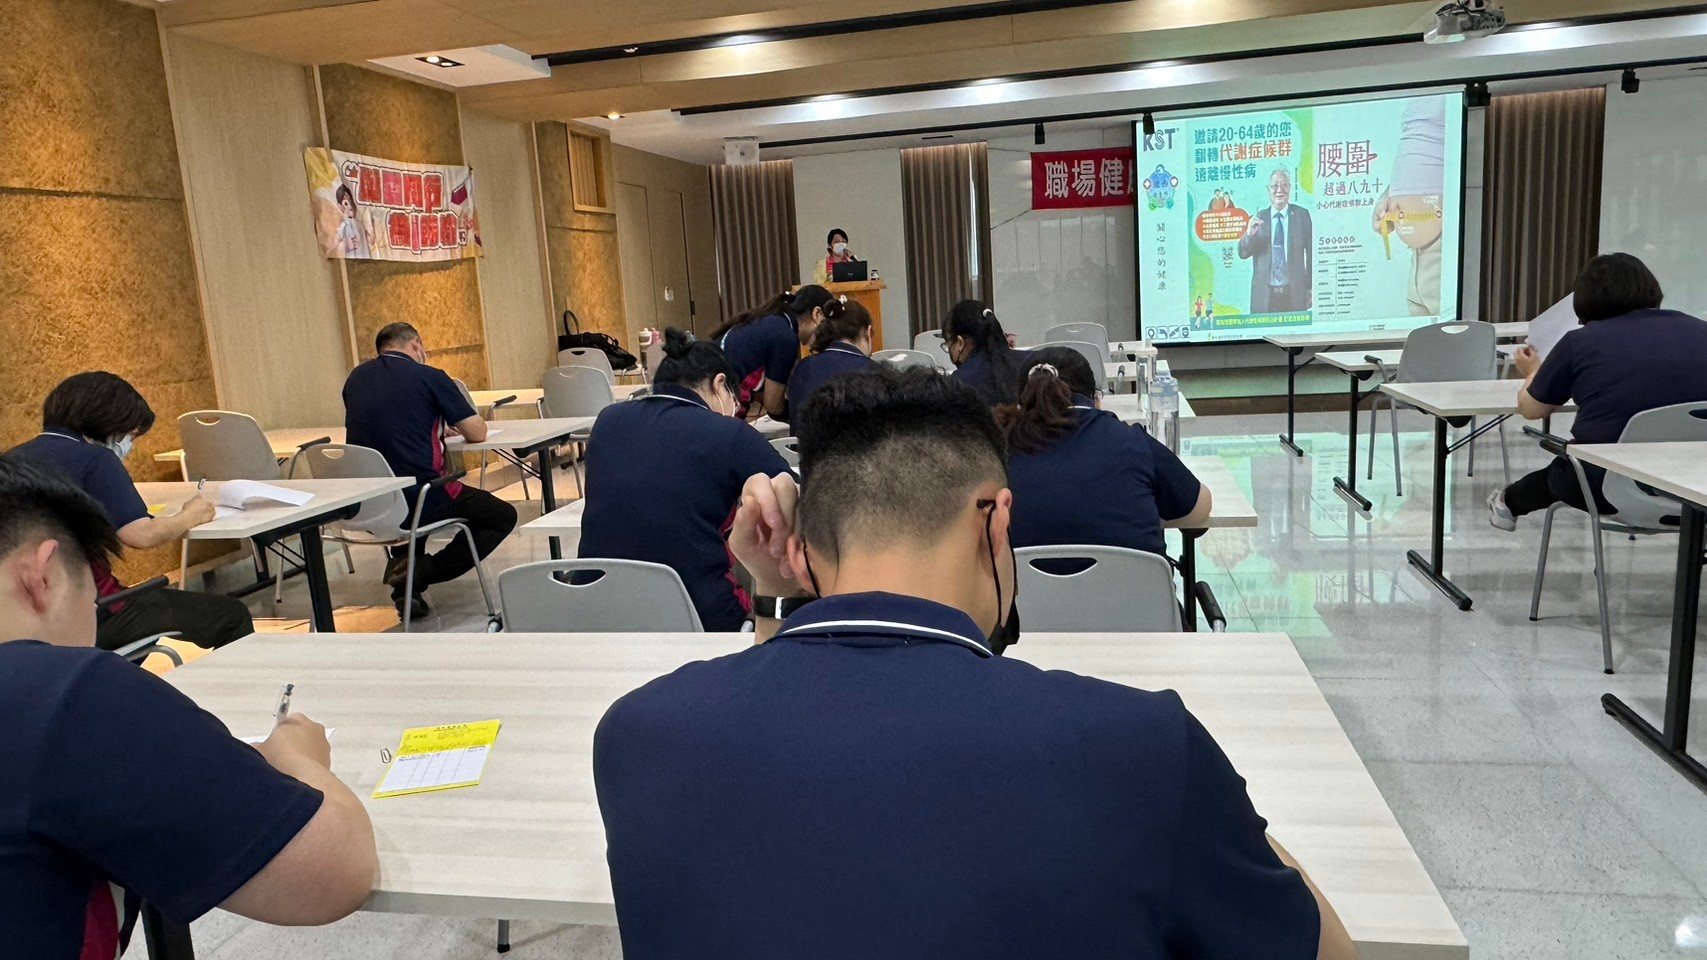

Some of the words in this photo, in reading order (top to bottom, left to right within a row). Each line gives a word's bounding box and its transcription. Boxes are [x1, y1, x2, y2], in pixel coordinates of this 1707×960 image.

[1143, 128, 1176, 151] KST
[1194, 122, 1292, 145] 邀請20-64歲的您
[1194, 139, 1292, 163] 翻轉代謝症候群
[1317, 140, 1377, 178] 腰圍
[1195, 163, 1256, 182] 遠離慢性病
[1323, 178, 1383, 196] 超過八九十
